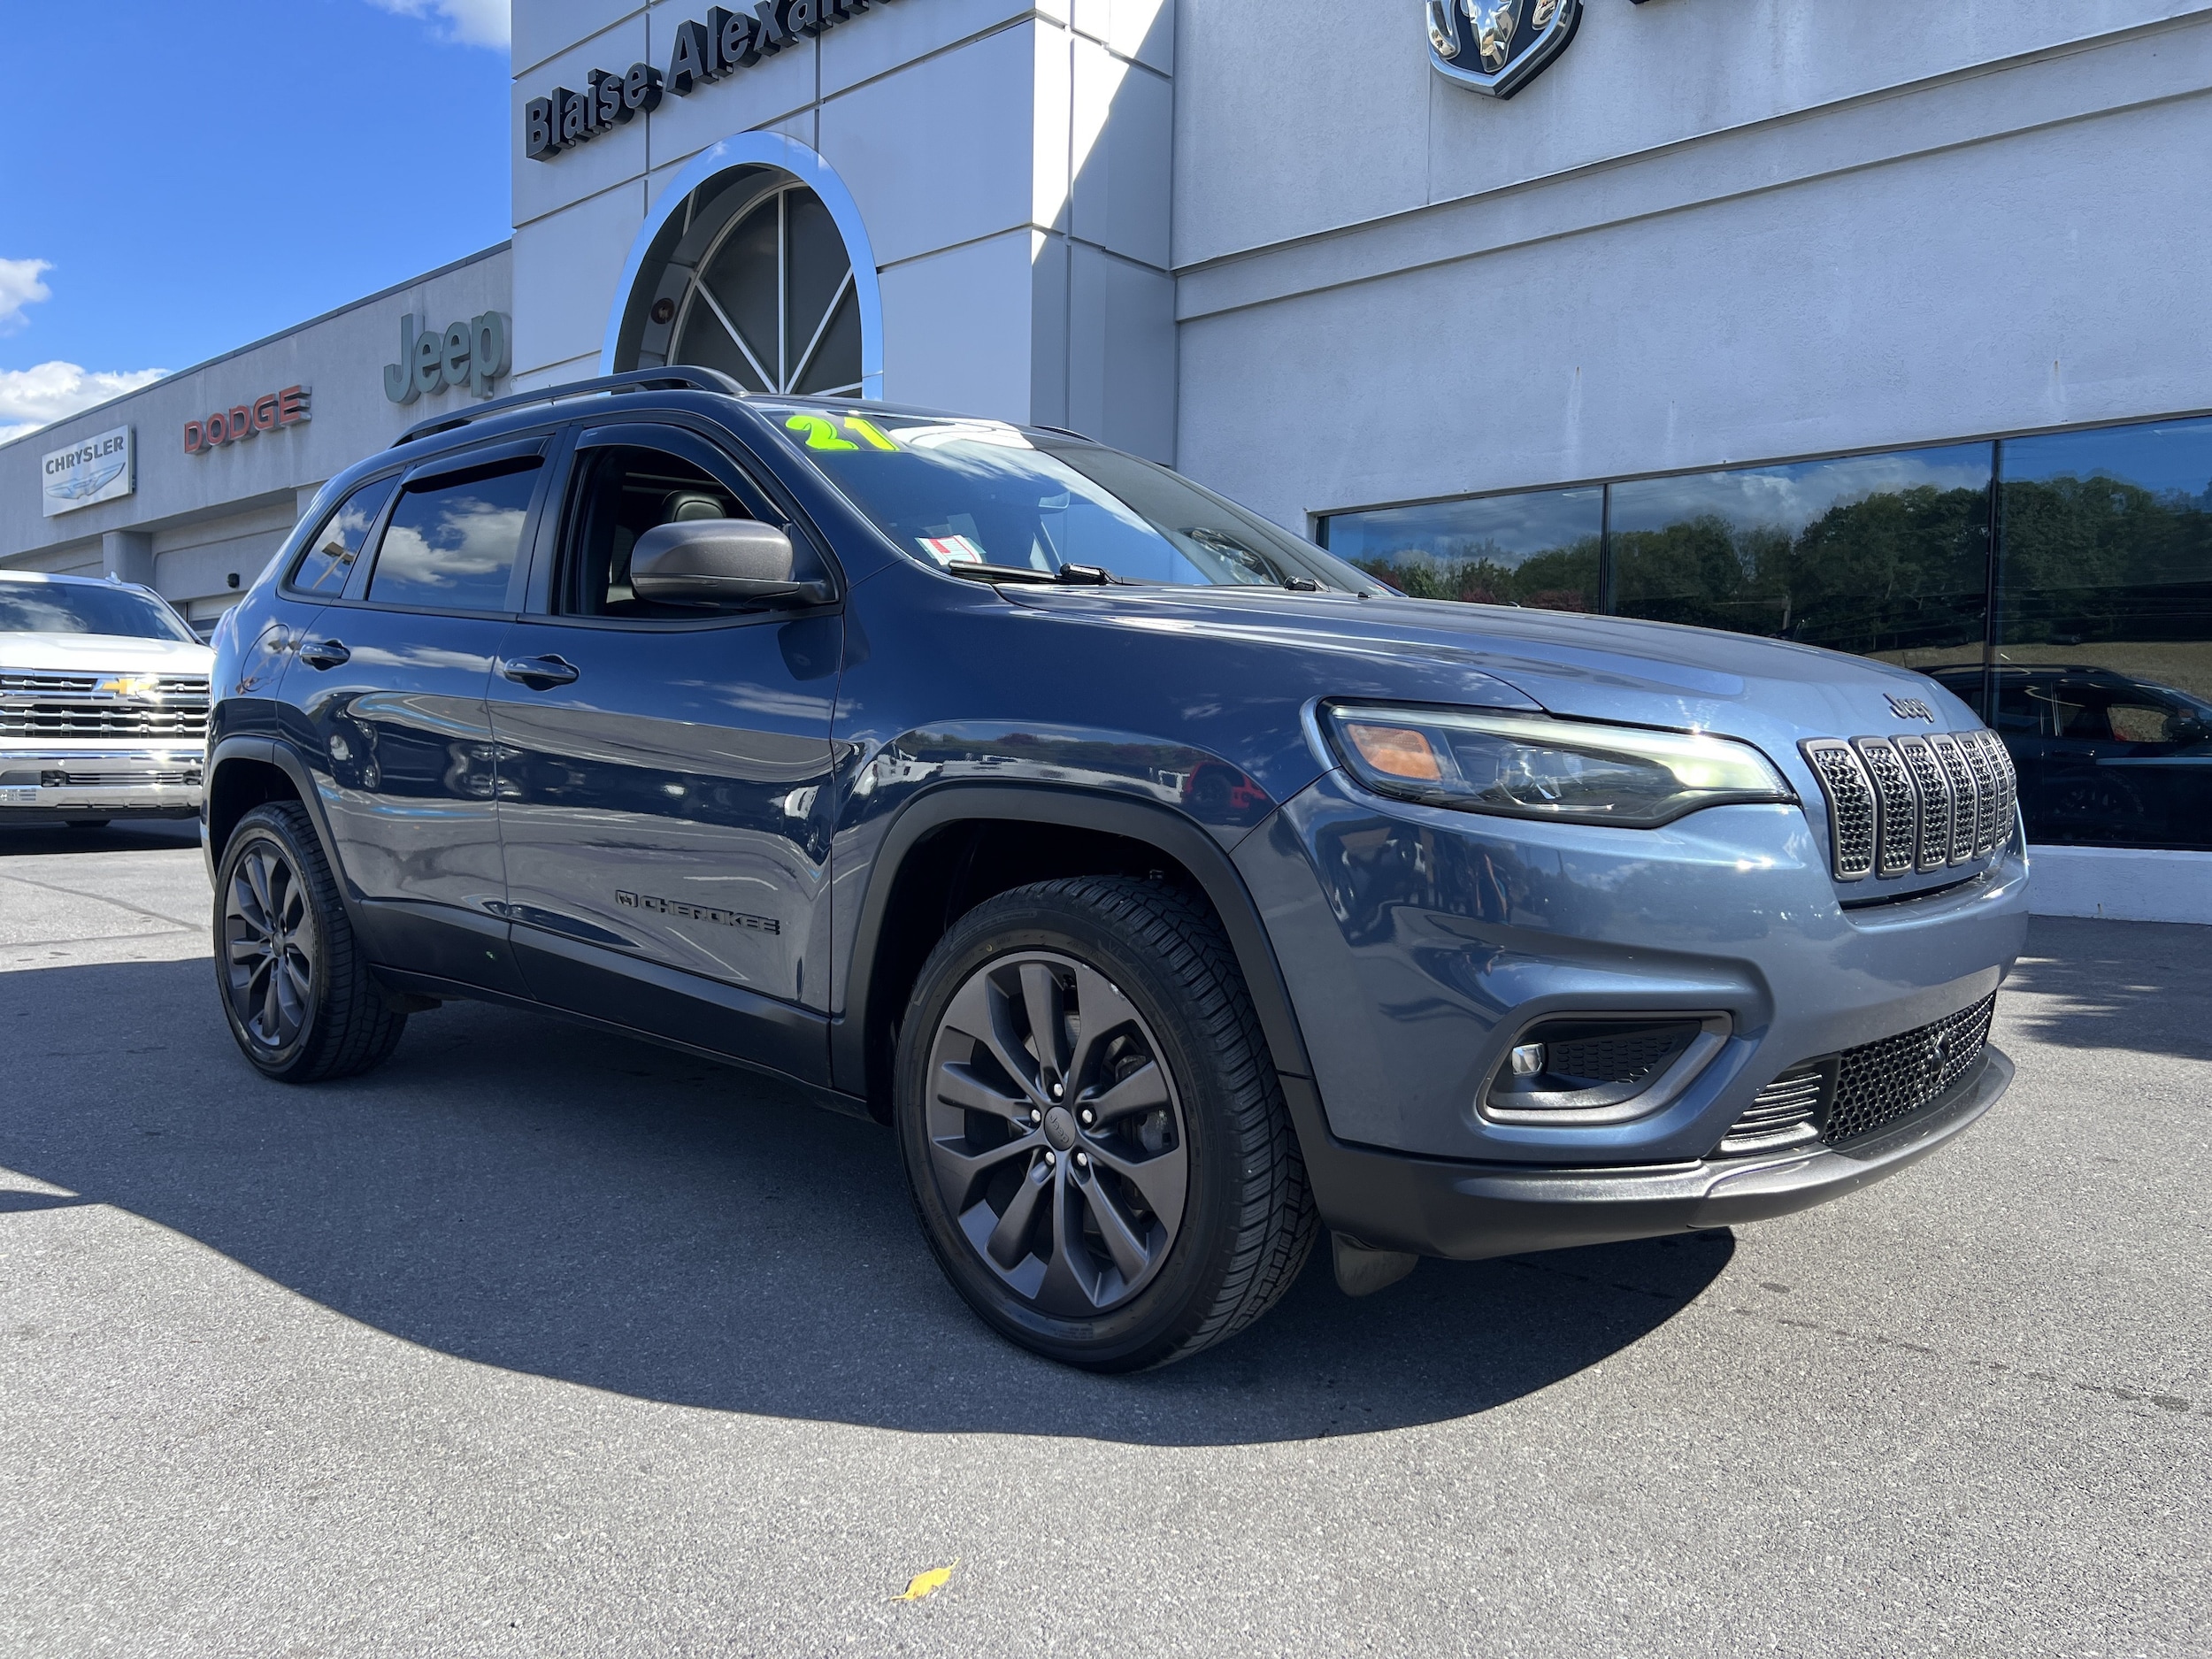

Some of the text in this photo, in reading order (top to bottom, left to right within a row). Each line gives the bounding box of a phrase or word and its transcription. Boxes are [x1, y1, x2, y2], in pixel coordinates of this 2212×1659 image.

[526, 62, 664, 162] Blaise
[383, 311, 512, 405] Jeep
[184, 384, 311, 455] DODGE
[786, 415, 901, 451] 21
[45, 435, 125, 476] CHRYSLER
[1883, 693, 1935, 723] Jeep
[640, 895, 780, 935] CHEROKEE
[1048, 1114, 1070, 1143] Jeep
